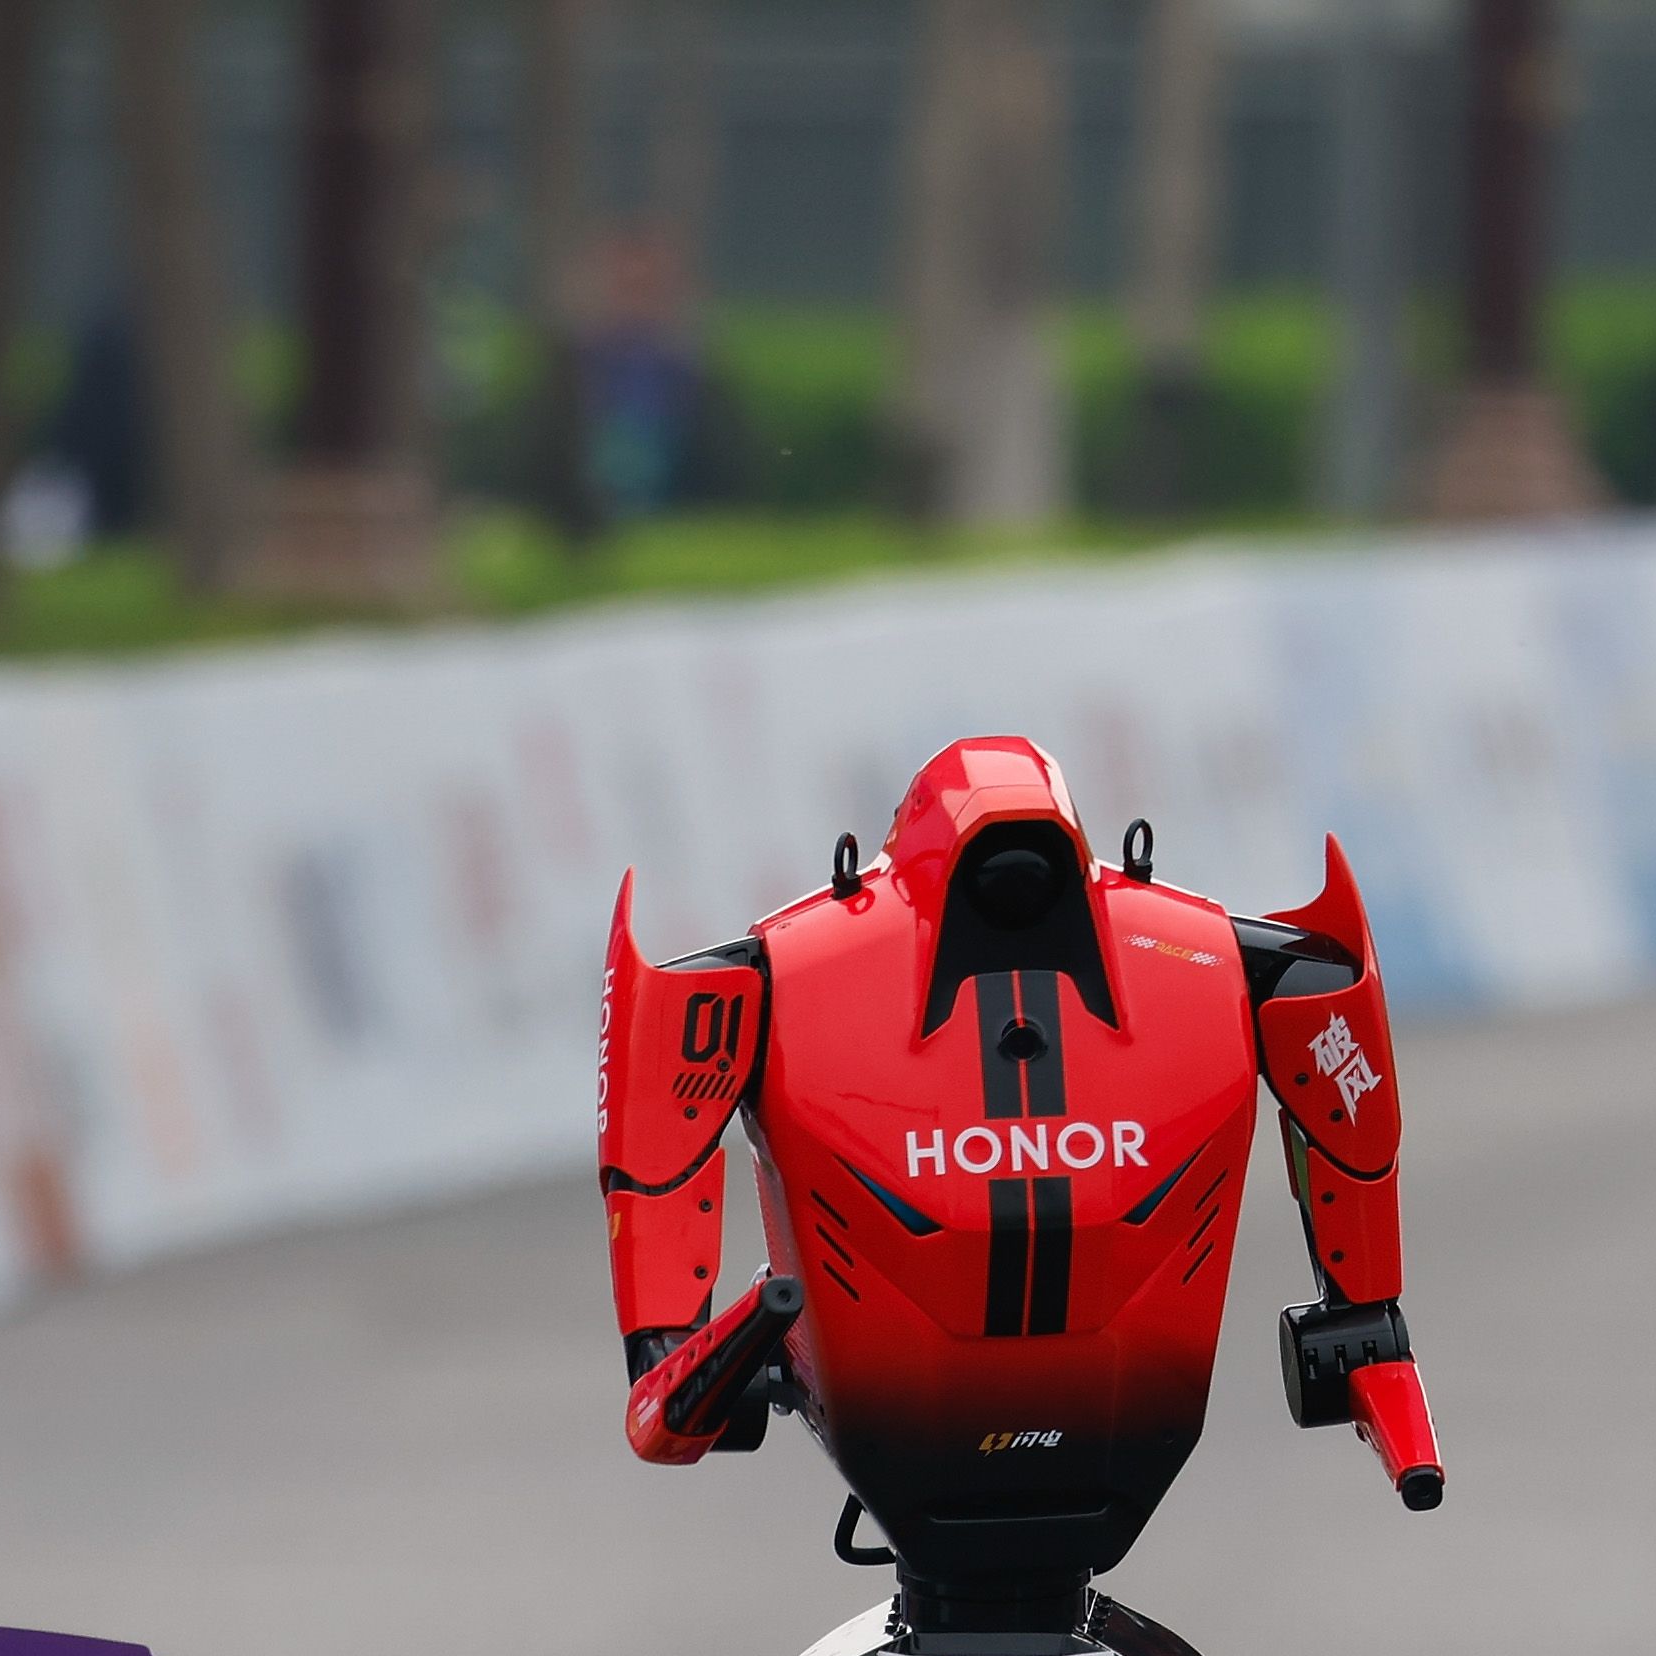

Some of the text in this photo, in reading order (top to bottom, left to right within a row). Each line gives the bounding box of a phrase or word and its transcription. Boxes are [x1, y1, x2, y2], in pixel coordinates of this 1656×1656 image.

[1155, 941, 1194, 961] RACE
[597, 967, 615, 1135] HONOR
[681, 992, 744, 1064] 01
[1306, 1010, 1383, 1128] 破风
[905, 1120, 1150, 1178] HONOR
[1009, 1428, 1064, 1449] 闪电
